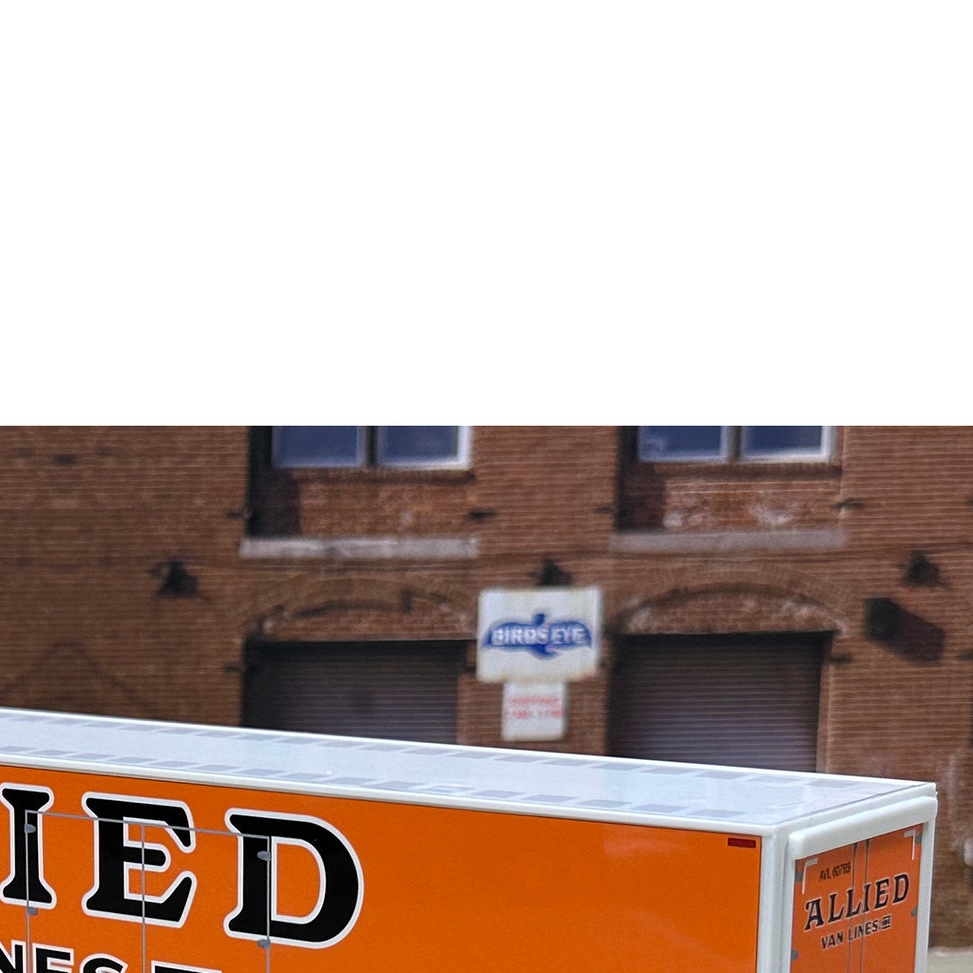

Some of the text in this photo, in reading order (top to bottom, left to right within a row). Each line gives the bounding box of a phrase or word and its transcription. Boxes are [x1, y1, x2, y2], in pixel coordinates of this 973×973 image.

[492, 626, 588, 645] BIRDS EYE
[804, 872, 910, 931] ALLIED
[821, 930, 844, 950] VAN
